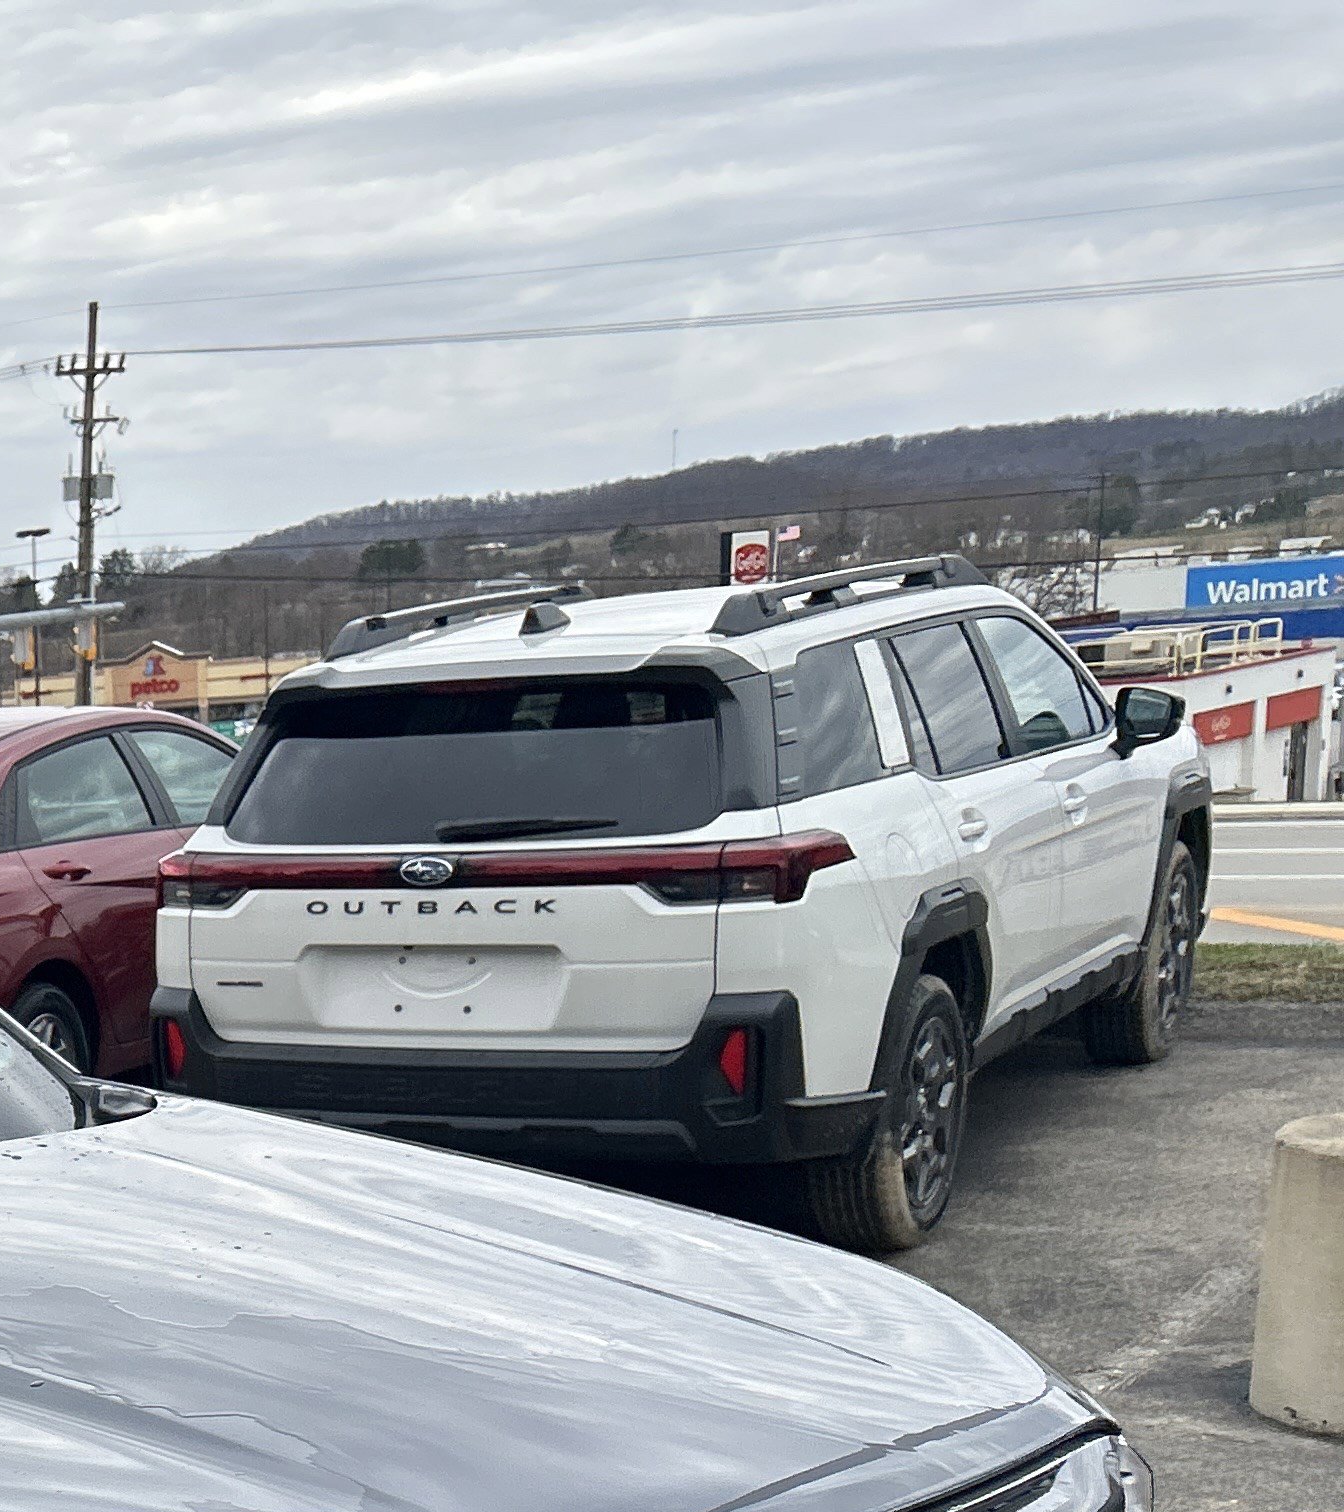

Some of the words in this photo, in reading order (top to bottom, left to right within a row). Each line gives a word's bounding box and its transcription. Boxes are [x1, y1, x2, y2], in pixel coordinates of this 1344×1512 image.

[1207, 573, 1329, 603] Walmart
[131, 678, 180, 700] petco
[305, 899, 556, 915] OUTBACK
